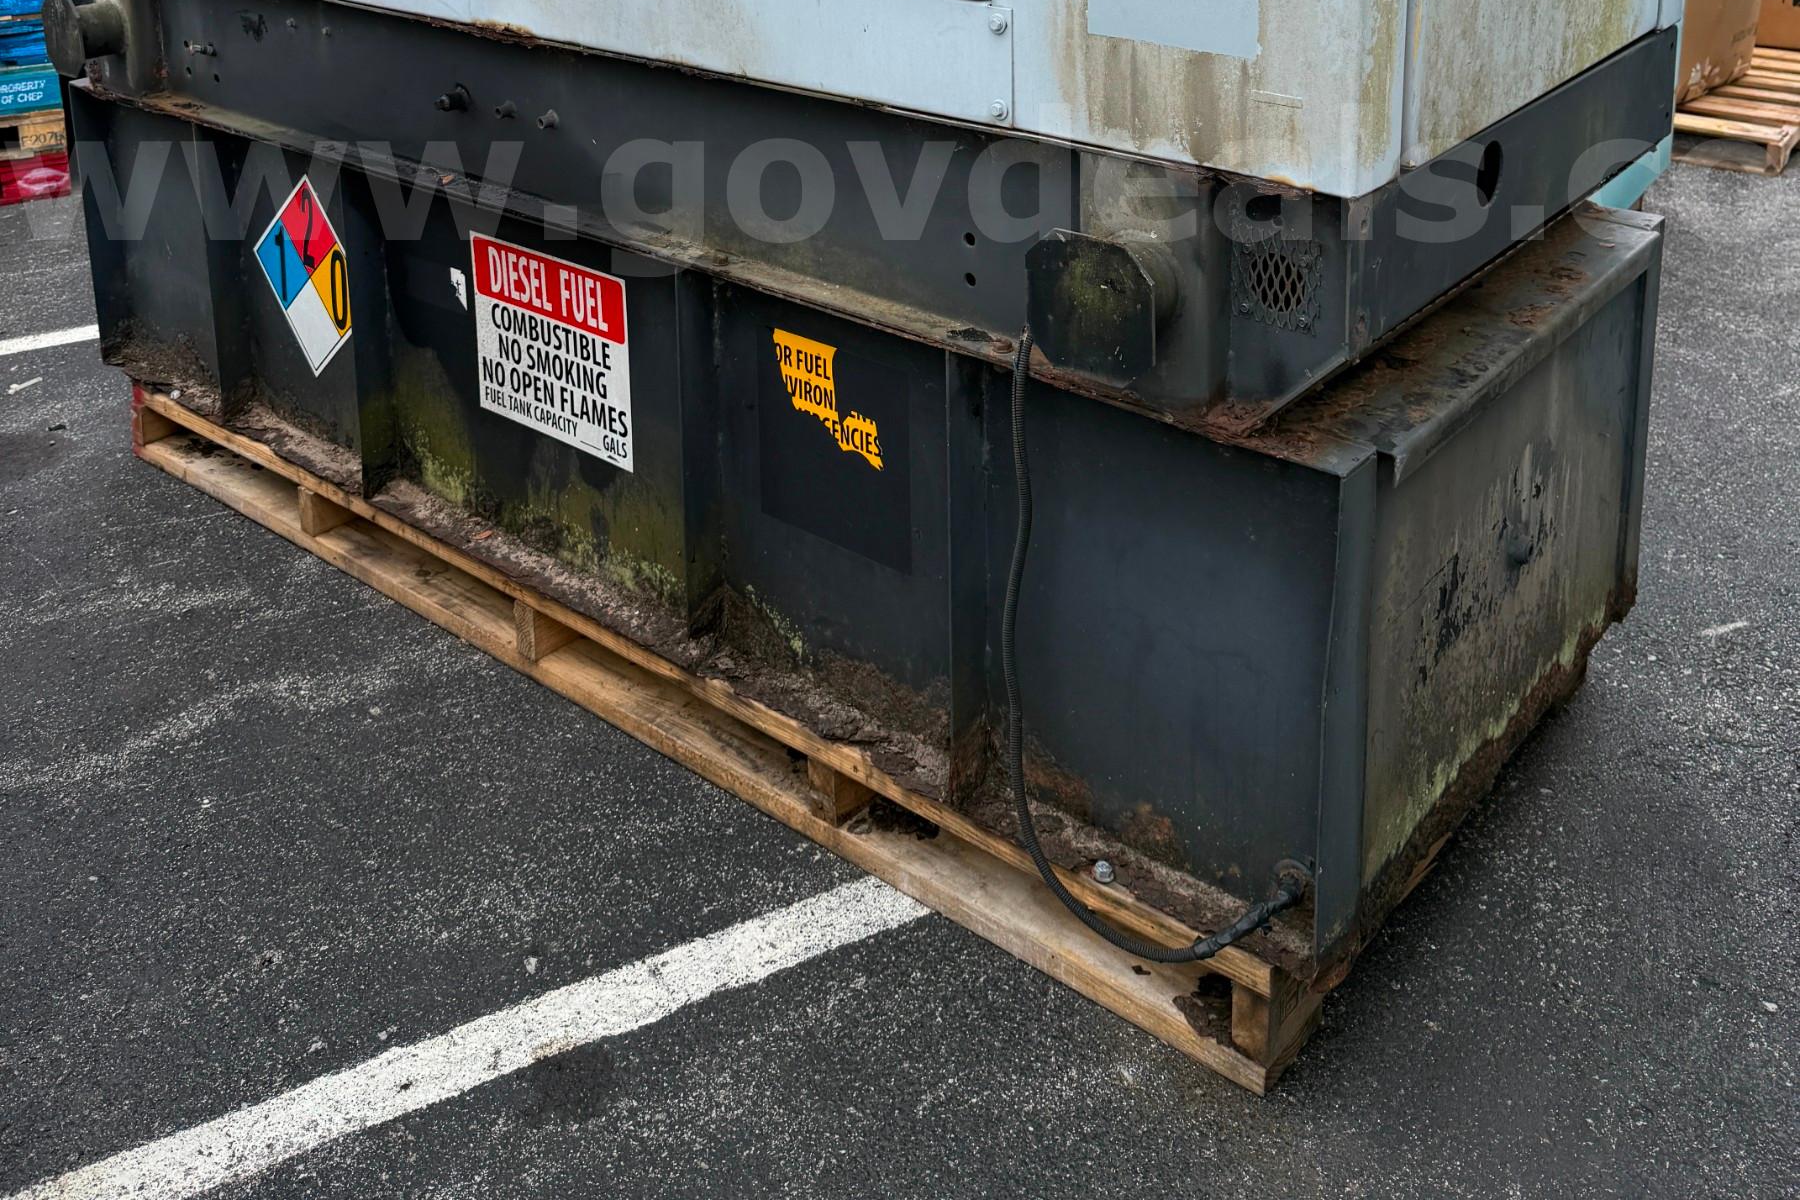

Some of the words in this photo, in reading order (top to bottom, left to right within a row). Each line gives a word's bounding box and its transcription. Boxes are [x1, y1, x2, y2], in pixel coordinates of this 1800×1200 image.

[1, 94, 14, 105] OF
[17, 91, 43, 103] CHEP
[301, 188, 315, 270] 2
[275, 226, 287, 301] 1
[330, 248, 348, 332] 0
[488, 246, 552, 312] DIESEL
[559, 269, 609, 332] FUEL
[491, 303, 612, 370] COMBUSTIBLE
[498, 333, 522, 365] NO
[527, 344, 607, 399] SMOKING
[796, 349, 831, 380] FUEL
[483, 356, 505, 387] NO
[510, 367, 554, 408] OPEN
[560, 386, 628, 438] FLAMES
[485, 386, 507, 408] FUEL
[508, 395, 532, 419] TANK
[534, 406, 578, 437] CAPACITY
[785, 374, 838, 412] VIRON
[602, 434, 628, 459] GALS
